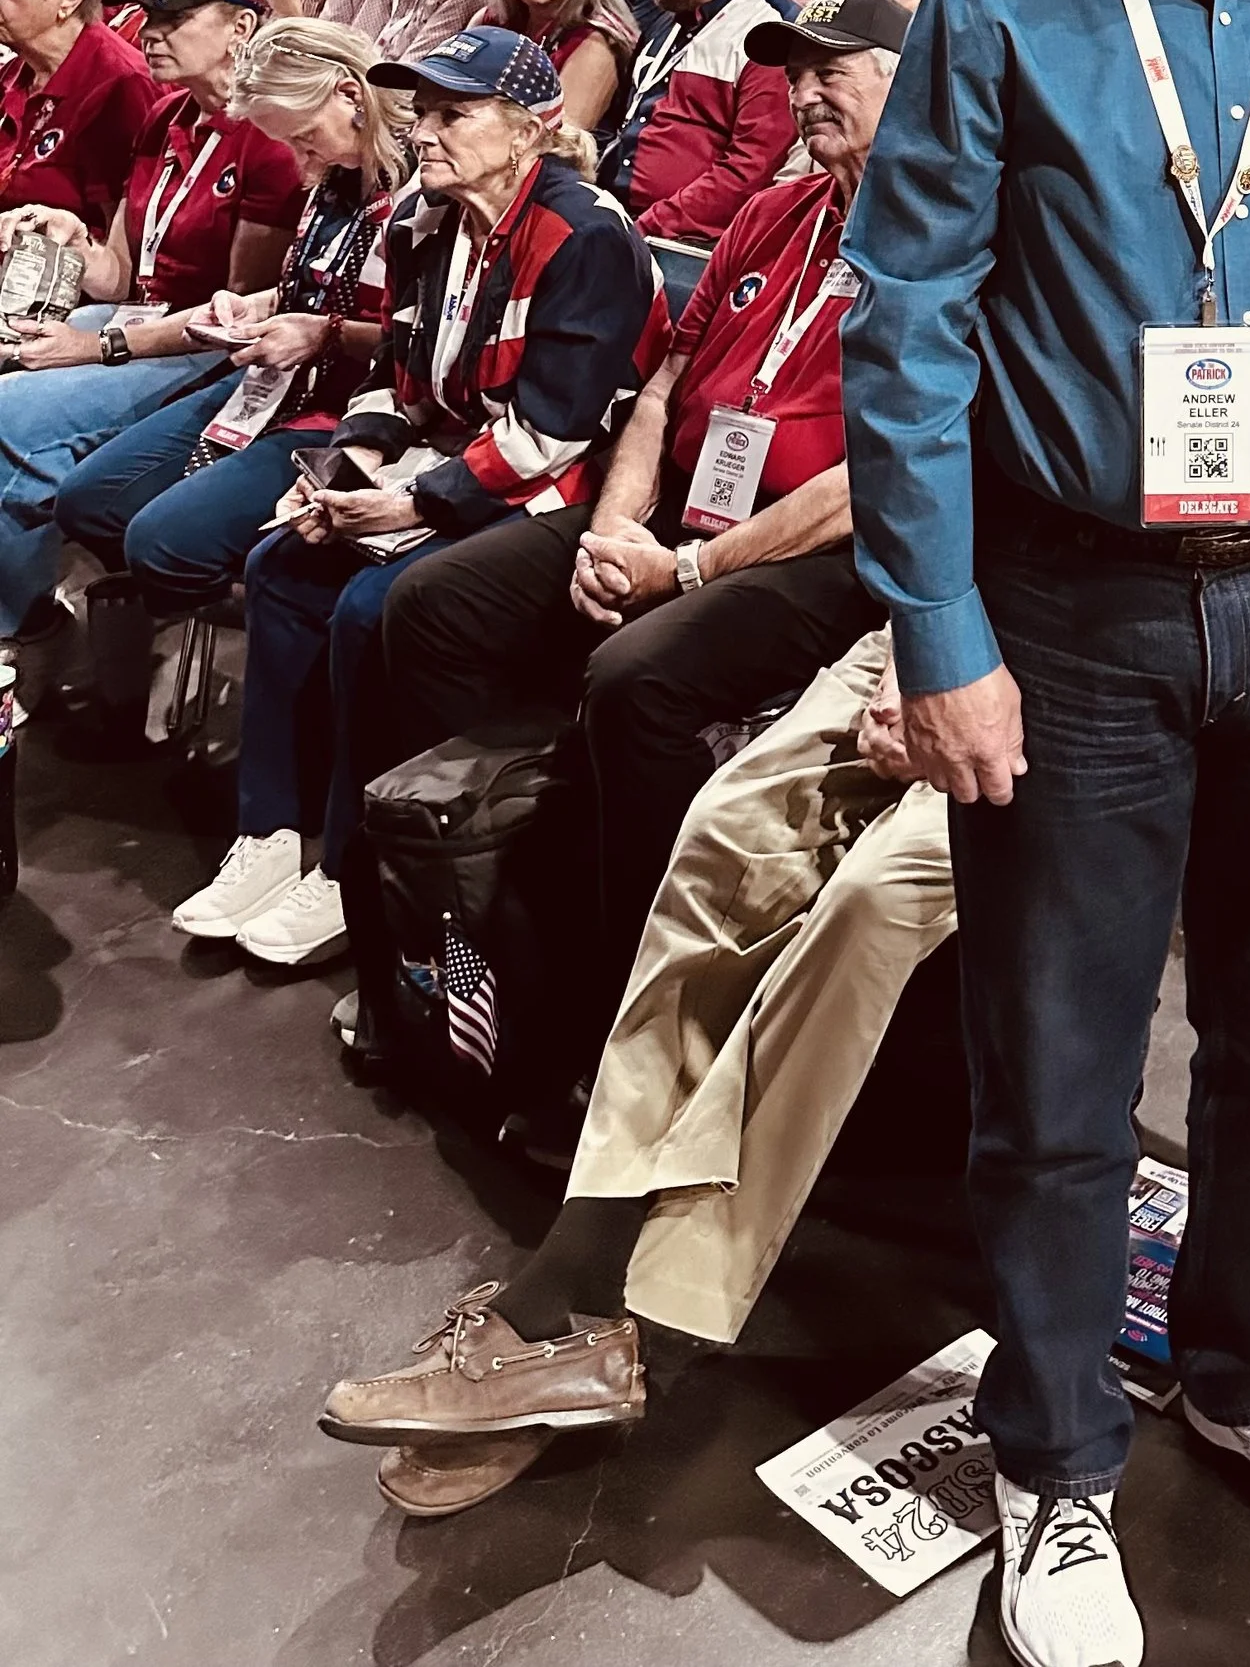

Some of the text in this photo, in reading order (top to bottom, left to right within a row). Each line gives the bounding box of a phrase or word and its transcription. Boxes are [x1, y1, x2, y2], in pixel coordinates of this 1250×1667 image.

[1191, 368, 1227, 381] PATRICK
[1182, 394, 1236, 404] ANDREW
[1189, 407, 1229, 418] ELLER
[1178, 500, 1239, 515] DELEGATE
[1129, 1214, 1163, 1231] FREE
[1140, 1299, 1168, 1324] TRIOT
[1106, 1354, 1131, 1372] SENA
[805, 1437, 869, 1479] Convention
[818, 1399, 987, 1525] ASCOSA
